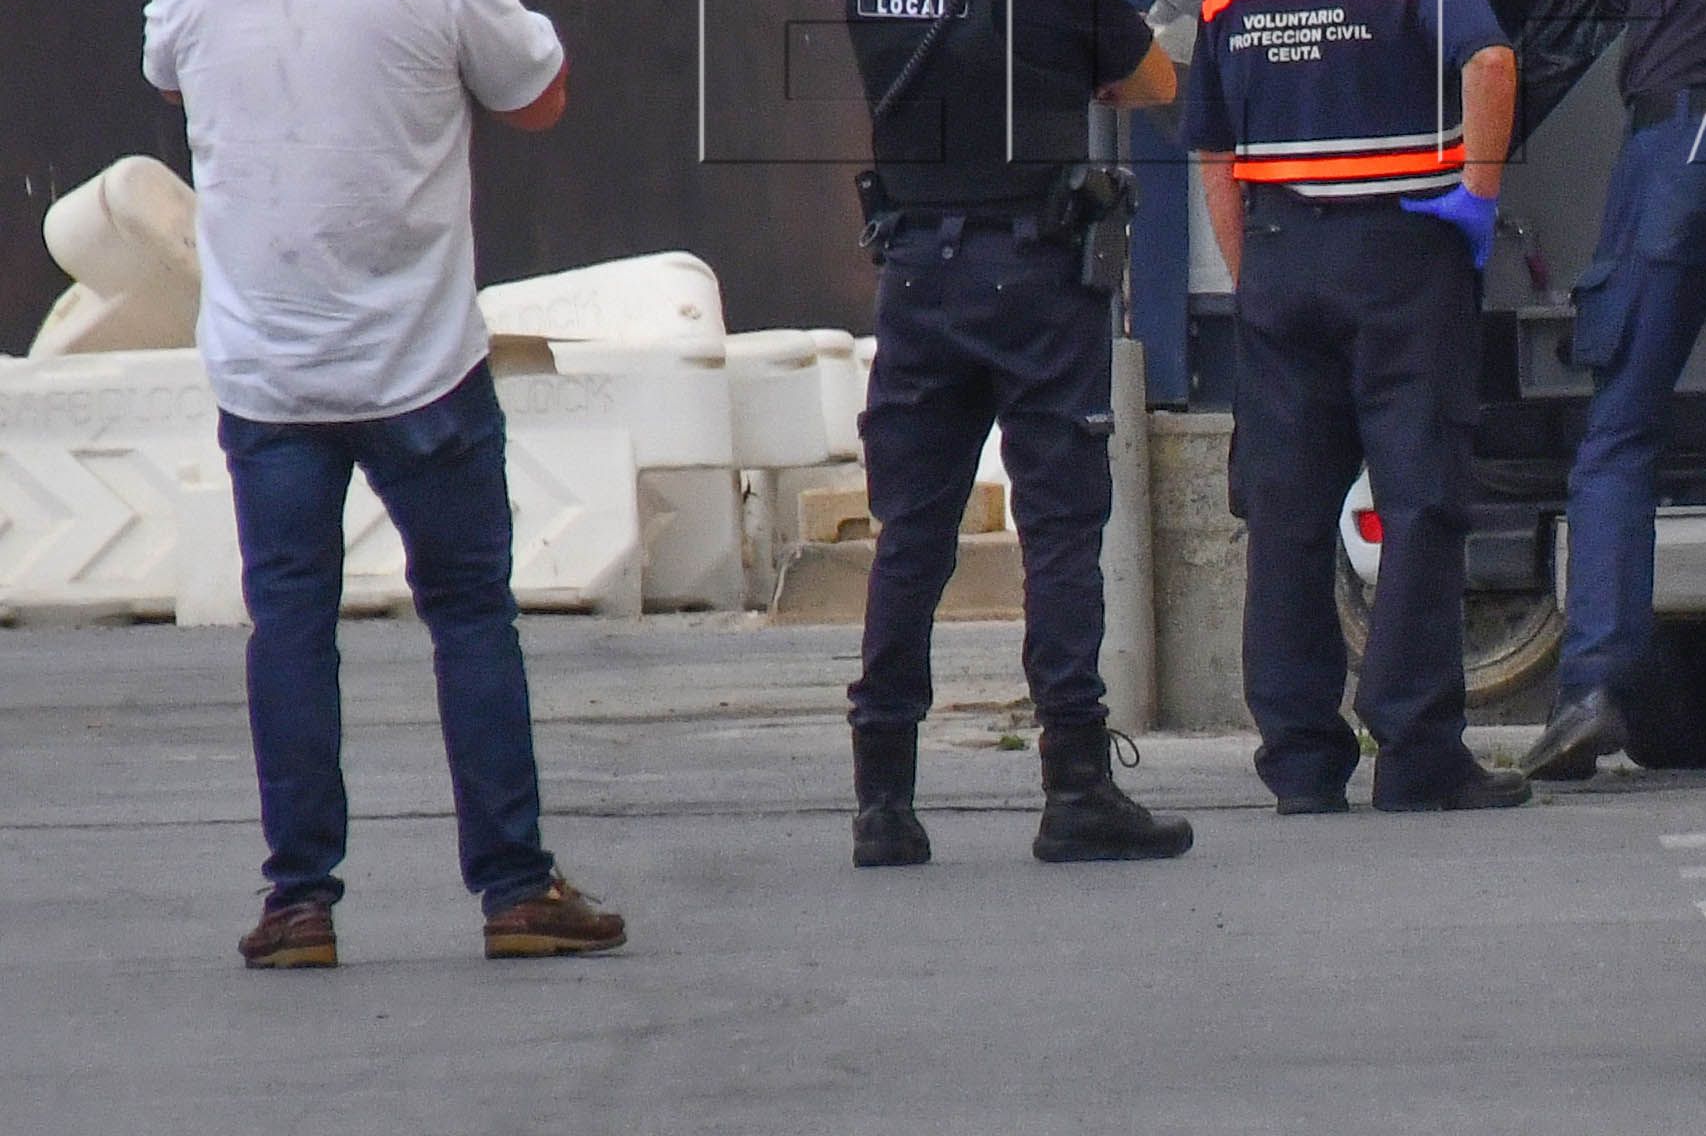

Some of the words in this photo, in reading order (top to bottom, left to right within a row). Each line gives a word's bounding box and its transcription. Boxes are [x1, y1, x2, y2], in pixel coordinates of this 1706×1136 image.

[1243, 8, 1345, 30] VOLUNTARIO
[1229, 28, 1322, 52] PROTECCION
[1325, 24, 1372, 41] CIVIL
[1267, 46, 1322, 63] CEUTA
